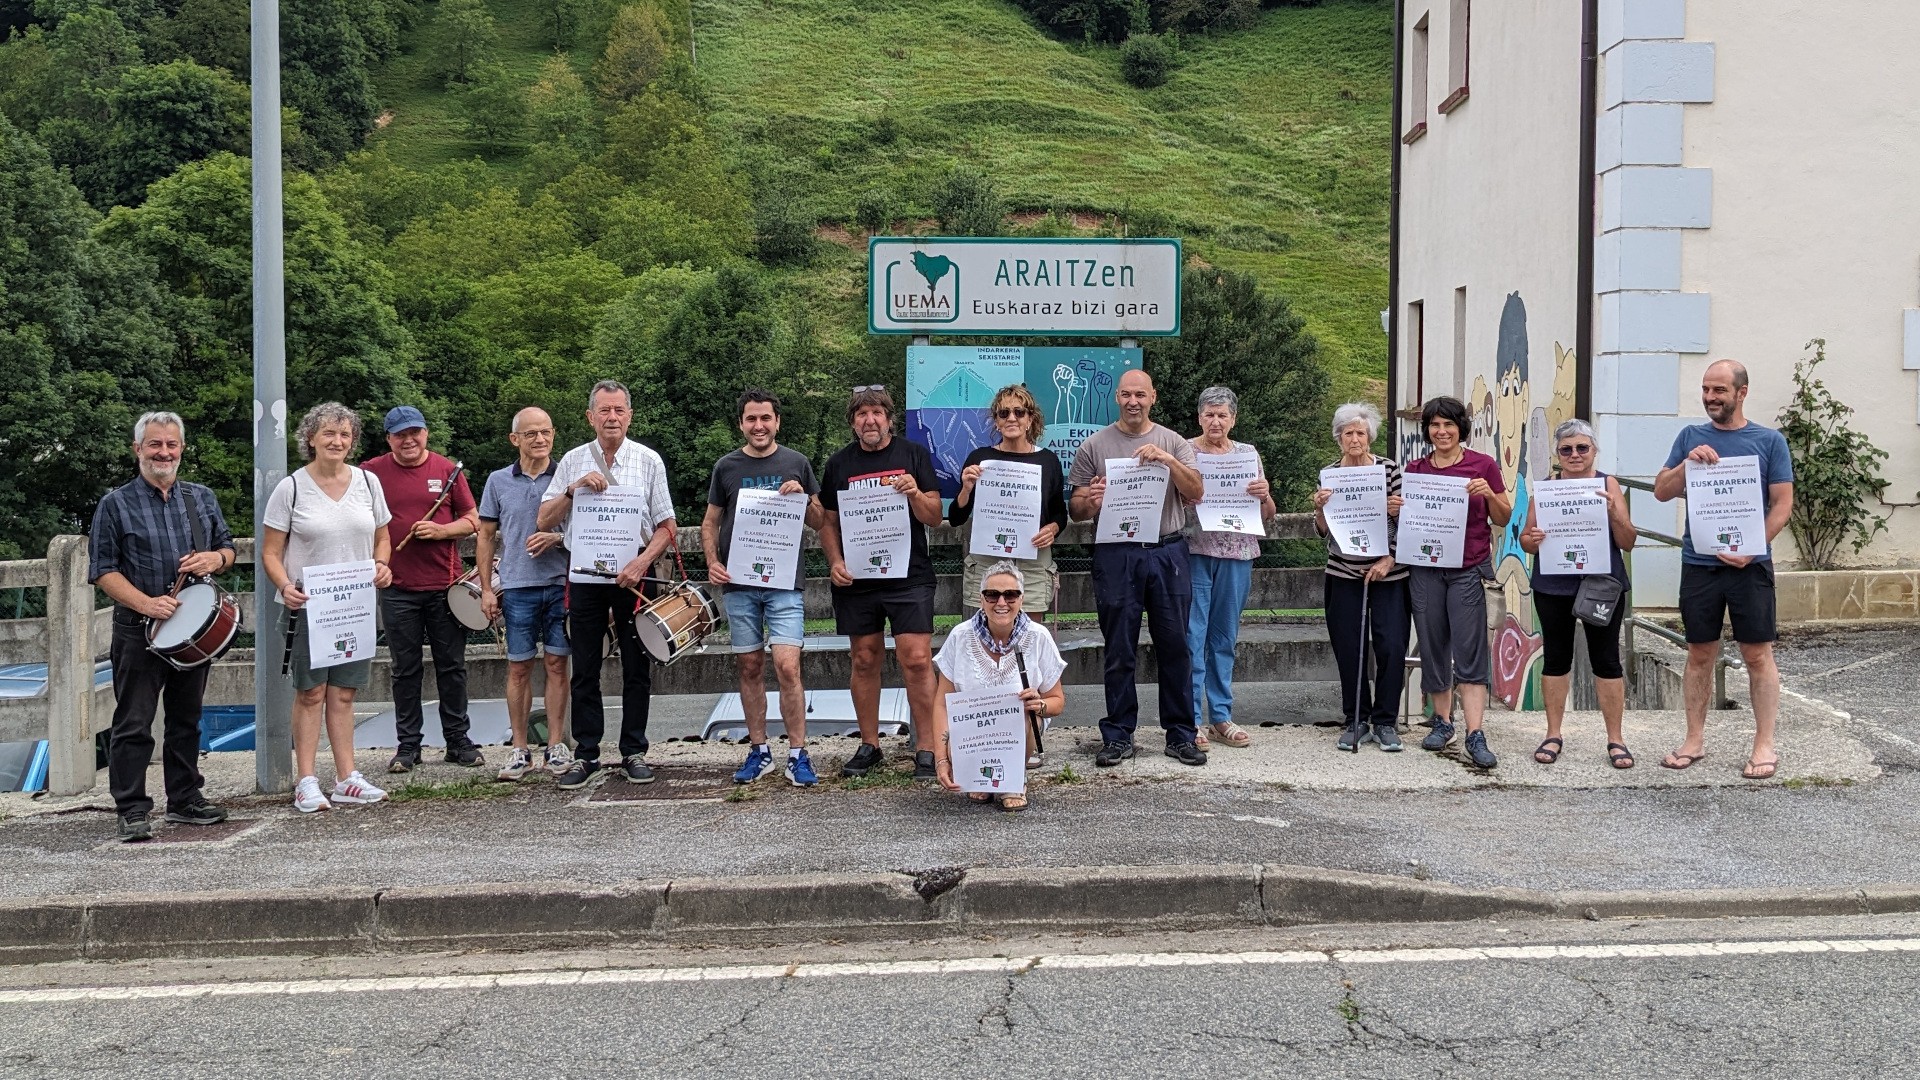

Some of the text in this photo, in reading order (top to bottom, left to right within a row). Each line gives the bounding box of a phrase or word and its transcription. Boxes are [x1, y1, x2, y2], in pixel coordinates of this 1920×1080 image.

[994, 259, 1135, 287] ARAITZen
[894, 294, 950, 308] UEMA
[973, 300, 1159, 317] Euskaraz bizi gara
[848, 477, 881, 490] ARAITZ
[980, 480, 1037, 491] EUSKARAREKIN
[1110, 476, 1164, 485] EUSKARAREKIN
[1691, 478, 1756, 487] EUSKARAREKIN
[1715, 487, 1734, 495] BAT
[1406, 493, 1464, 503] EUSKARAREKIN
[1539, 499, 1602, 508] EUSKARAREKIN
[578, 506, 639, 514] EUSKARAREKIN
[740, 508, 800, 520] EUSKARAREKIN
[844, 504, 904, 517] EUSKARAREKIN
[760, 518, 778, 526] BAT
[310, 582, 372, 595] EUSKARAREKIN
[334, 593, 352, 601] BAT
[953, 707, 1019, 722] EUSKARAREKIN
[977, 718, 997, 727] BAT
